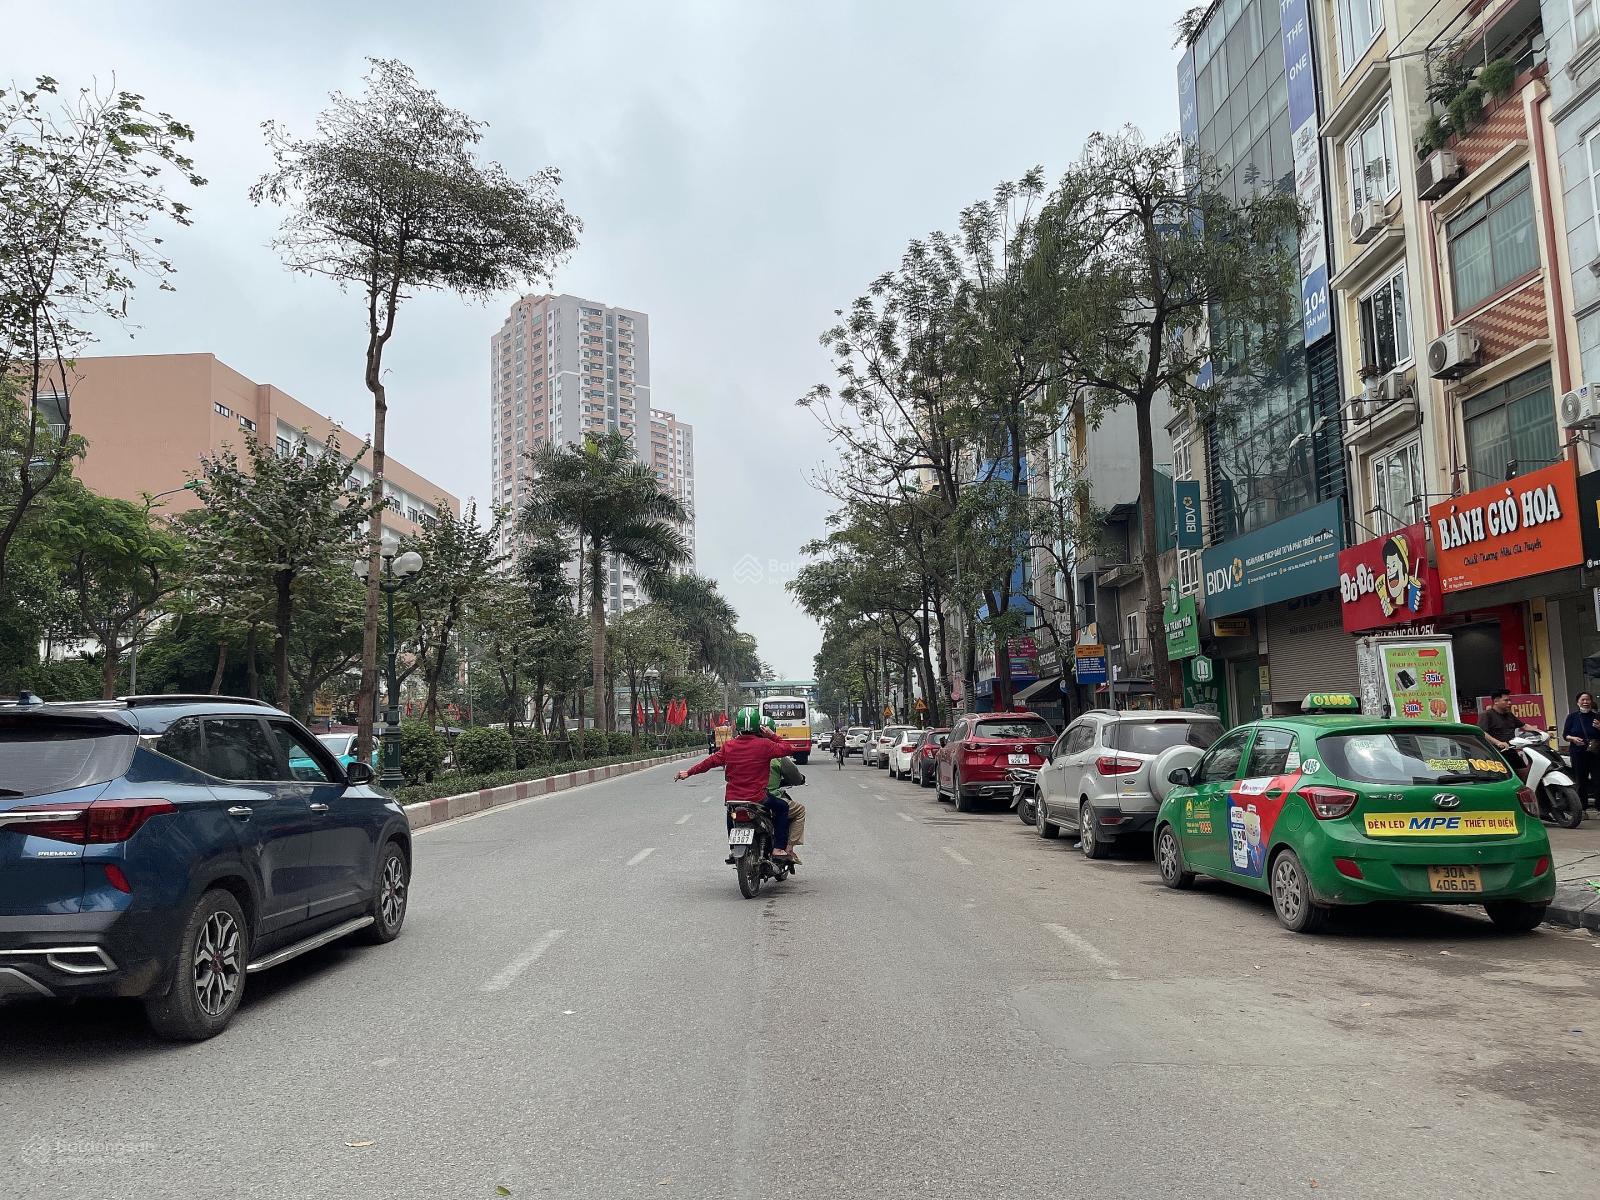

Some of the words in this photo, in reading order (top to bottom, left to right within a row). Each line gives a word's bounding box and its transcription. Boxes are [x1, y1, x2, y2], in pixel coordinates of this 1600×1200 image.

[1287, 18, 1304, 45] THE
[1289, 53, 1307, 81] ONE
[1305, 286, 1326, 317] 104
[1185, 506, 1196, 533] BIDV
[1438, 505, 1486, 551] BÁNH
[1487, 487, 1518, 537] GIÒ
[1520, 483, 1561, 528] HOA
[1206, 565, 1233, 595] BIDV
[1505, 663, 1517, 672] 102
[1426, 673, 1441, 682] 35k
[1322, 694, 1352, 706] 1055
[1468, 758, 1508, 774] 1055
[1368, 820, 1387, 829] ĐÈN
[1388, 820, 1405, 829] LED
[1408, 816, 1462, 830] MPE
[1464, 816, 1486, 828] THIẾT
[1488, 819, 1497, 829] BỊ
[1498, 818, 1514, 828] ĐIỆN
[1443, 867, 1466, 878] 30A
[1436, 879, 1477, 891] 406.05
